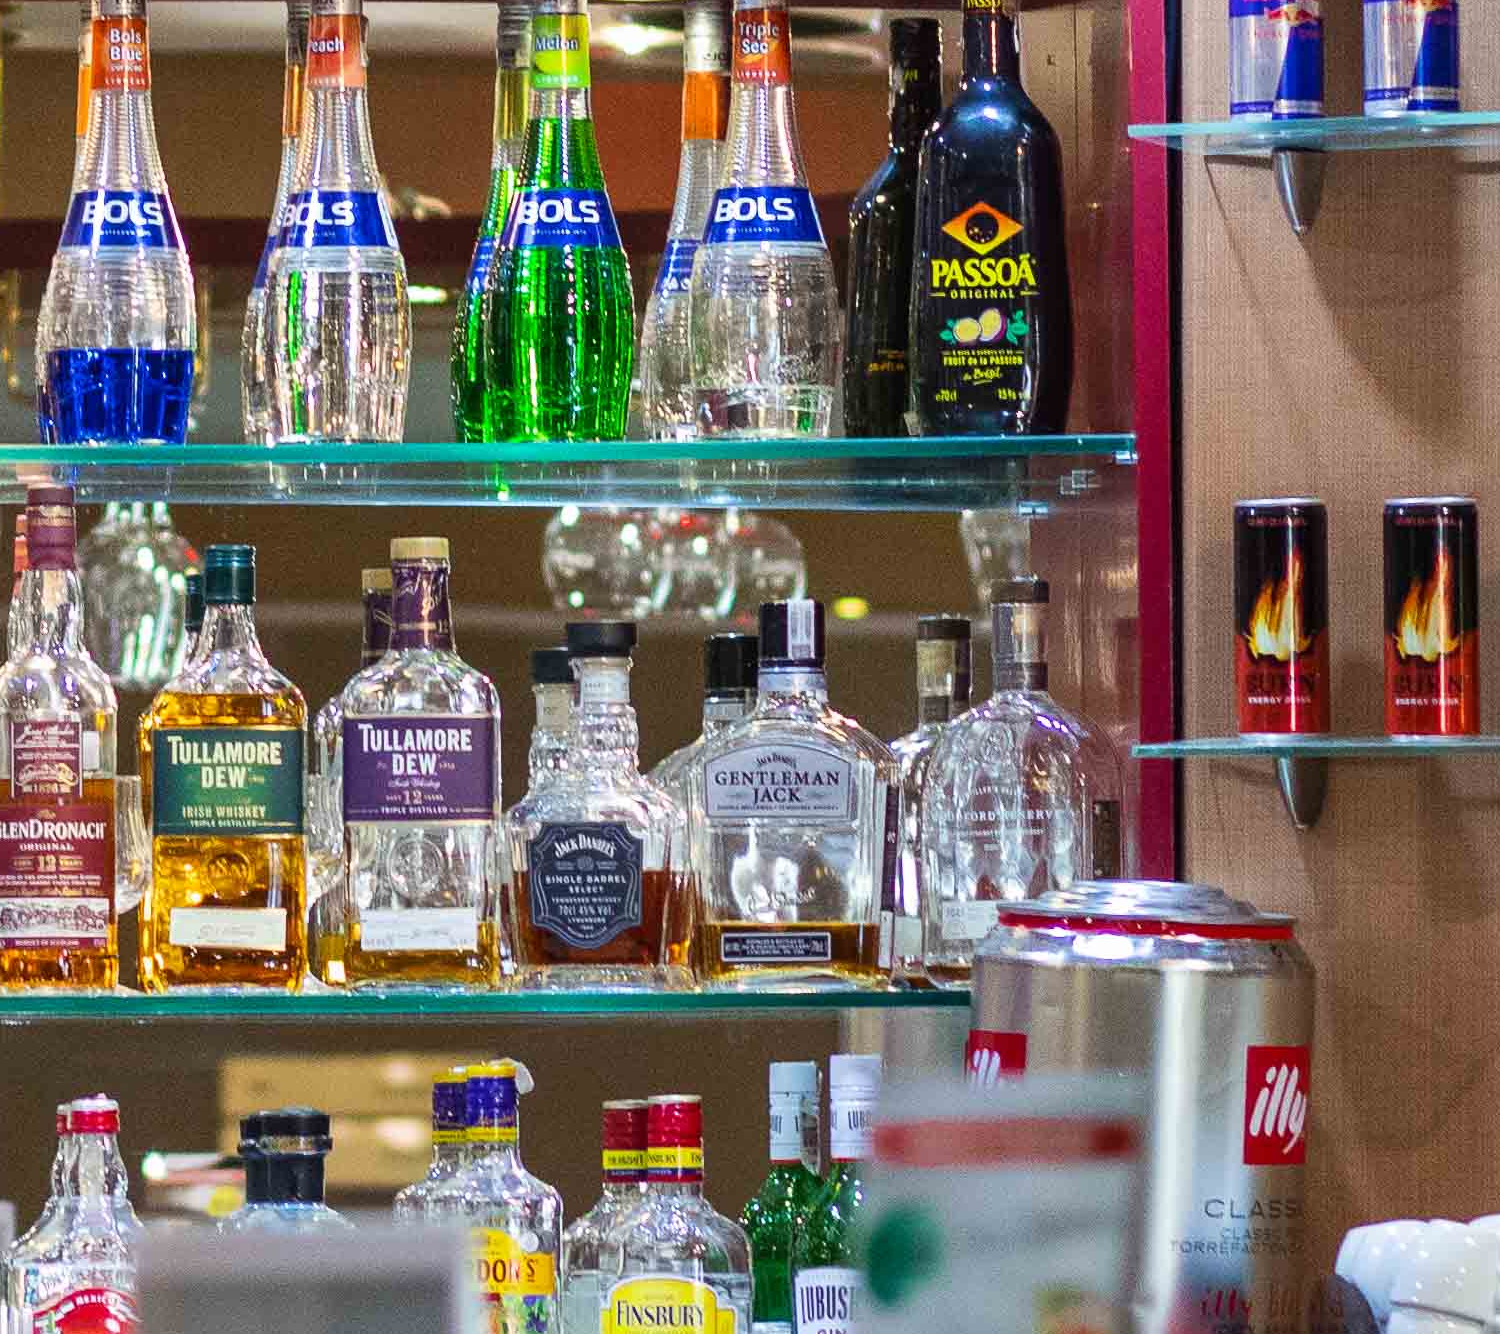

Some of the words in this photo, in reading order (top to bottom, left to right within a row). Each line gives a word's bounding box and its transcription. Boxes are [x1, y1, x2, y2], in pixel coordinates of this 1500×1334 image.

[109, 28, 142, 44] Bols
[738, 21, 780, 39] Triple
[109, 46, 143, 61] Blue
[534, 35, 579, 52] Melon
[741, 38, 769, 55] Sec
[82, 199, 165, 226] BOLS
[280, 200, 356, 227] BOLS
[518, 198, 601, 224] BOLS
[713, 196, 796, 223] BOLS
[950, 288, 1016, 300] ORIGINAL
[358, 722, 473, 753] TULLAMORE
[167, 735, 283, 765] TULLAMORE
[391, 753, 437, 776] DEW
[200, 765, 247, 788] DEW
[714, 770, 841, 786] GENTLEMAN
[403, 790, 423, 806] 12
[752, 787, 802, 805] JACK
[182, 805, 212, 819] IRISH
[215, 804, 266, 819] WHISKEY
[545, 874, 582, 885] SINGLE
[586, 874, 627, 885] BARREL
[1248, 1063, 1307, 1156] illy
[1204, 1198, 1300, 1221] CLASS
[476, 1257, 537, 1284] DON'S
[616, 1299, 705, 1328] FINSBURY
[799, 1283, 855, 1325] LUBUS
